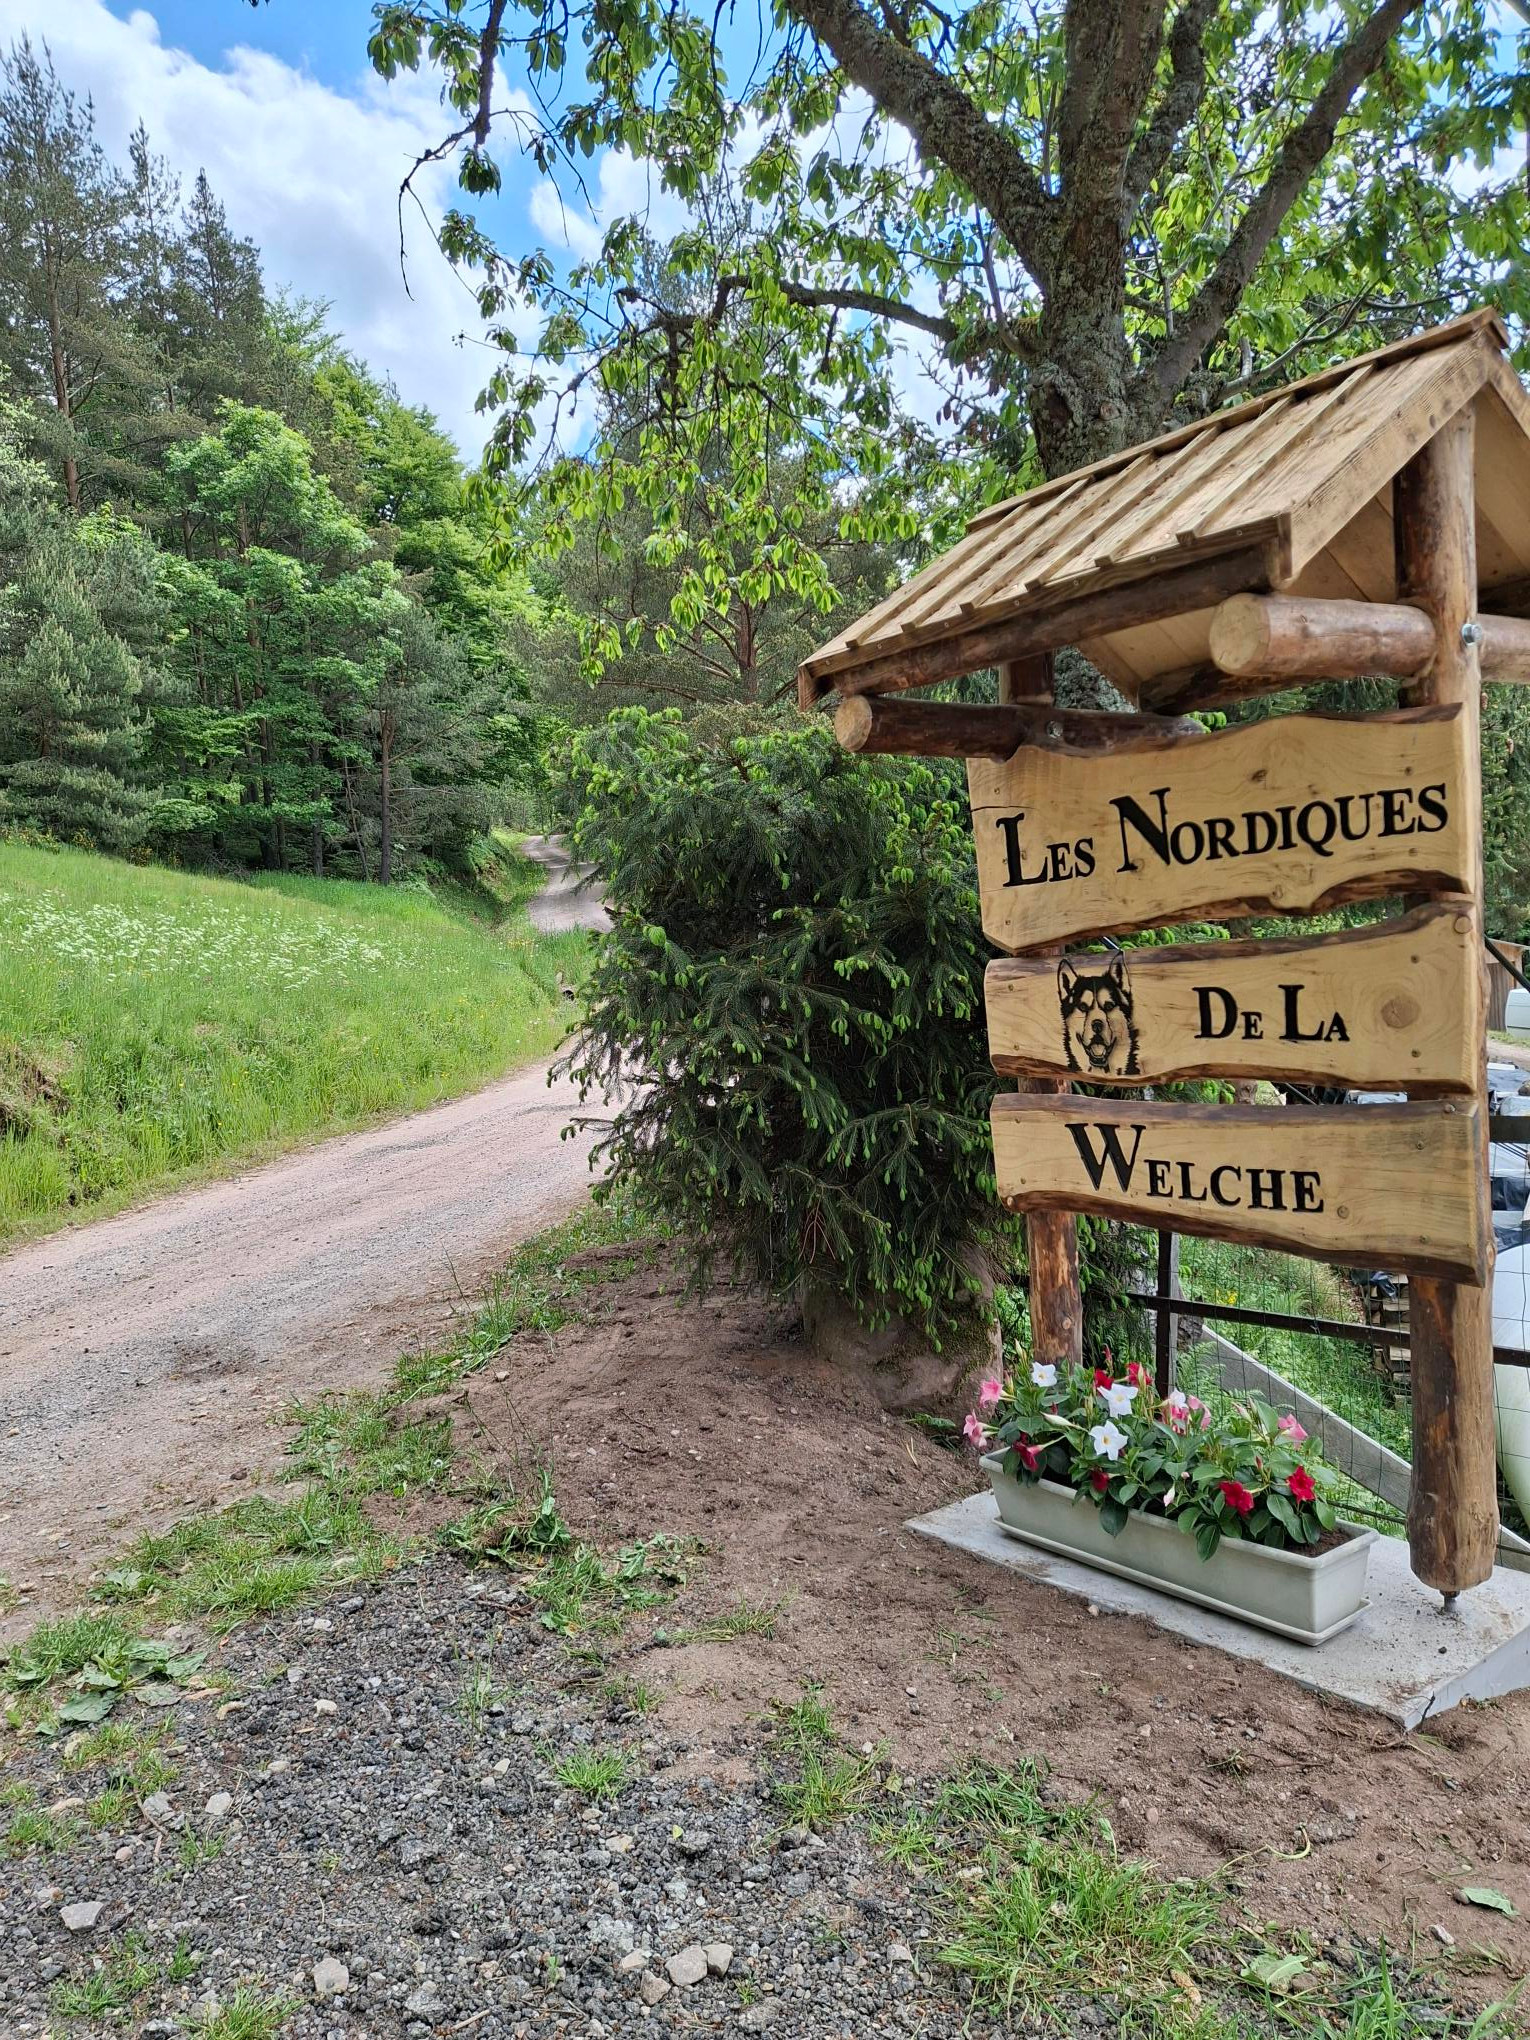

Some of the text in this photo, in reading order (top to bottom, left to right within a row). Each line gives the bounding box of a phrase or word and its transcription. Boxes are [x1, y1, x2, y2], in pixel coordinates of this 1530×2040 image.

[996, 782, 1449, 888] LES NORDIQUES
[1192, 983, 1350, 1042] DE LA
[1064, 1122, 1325, 1214] WELCHE
